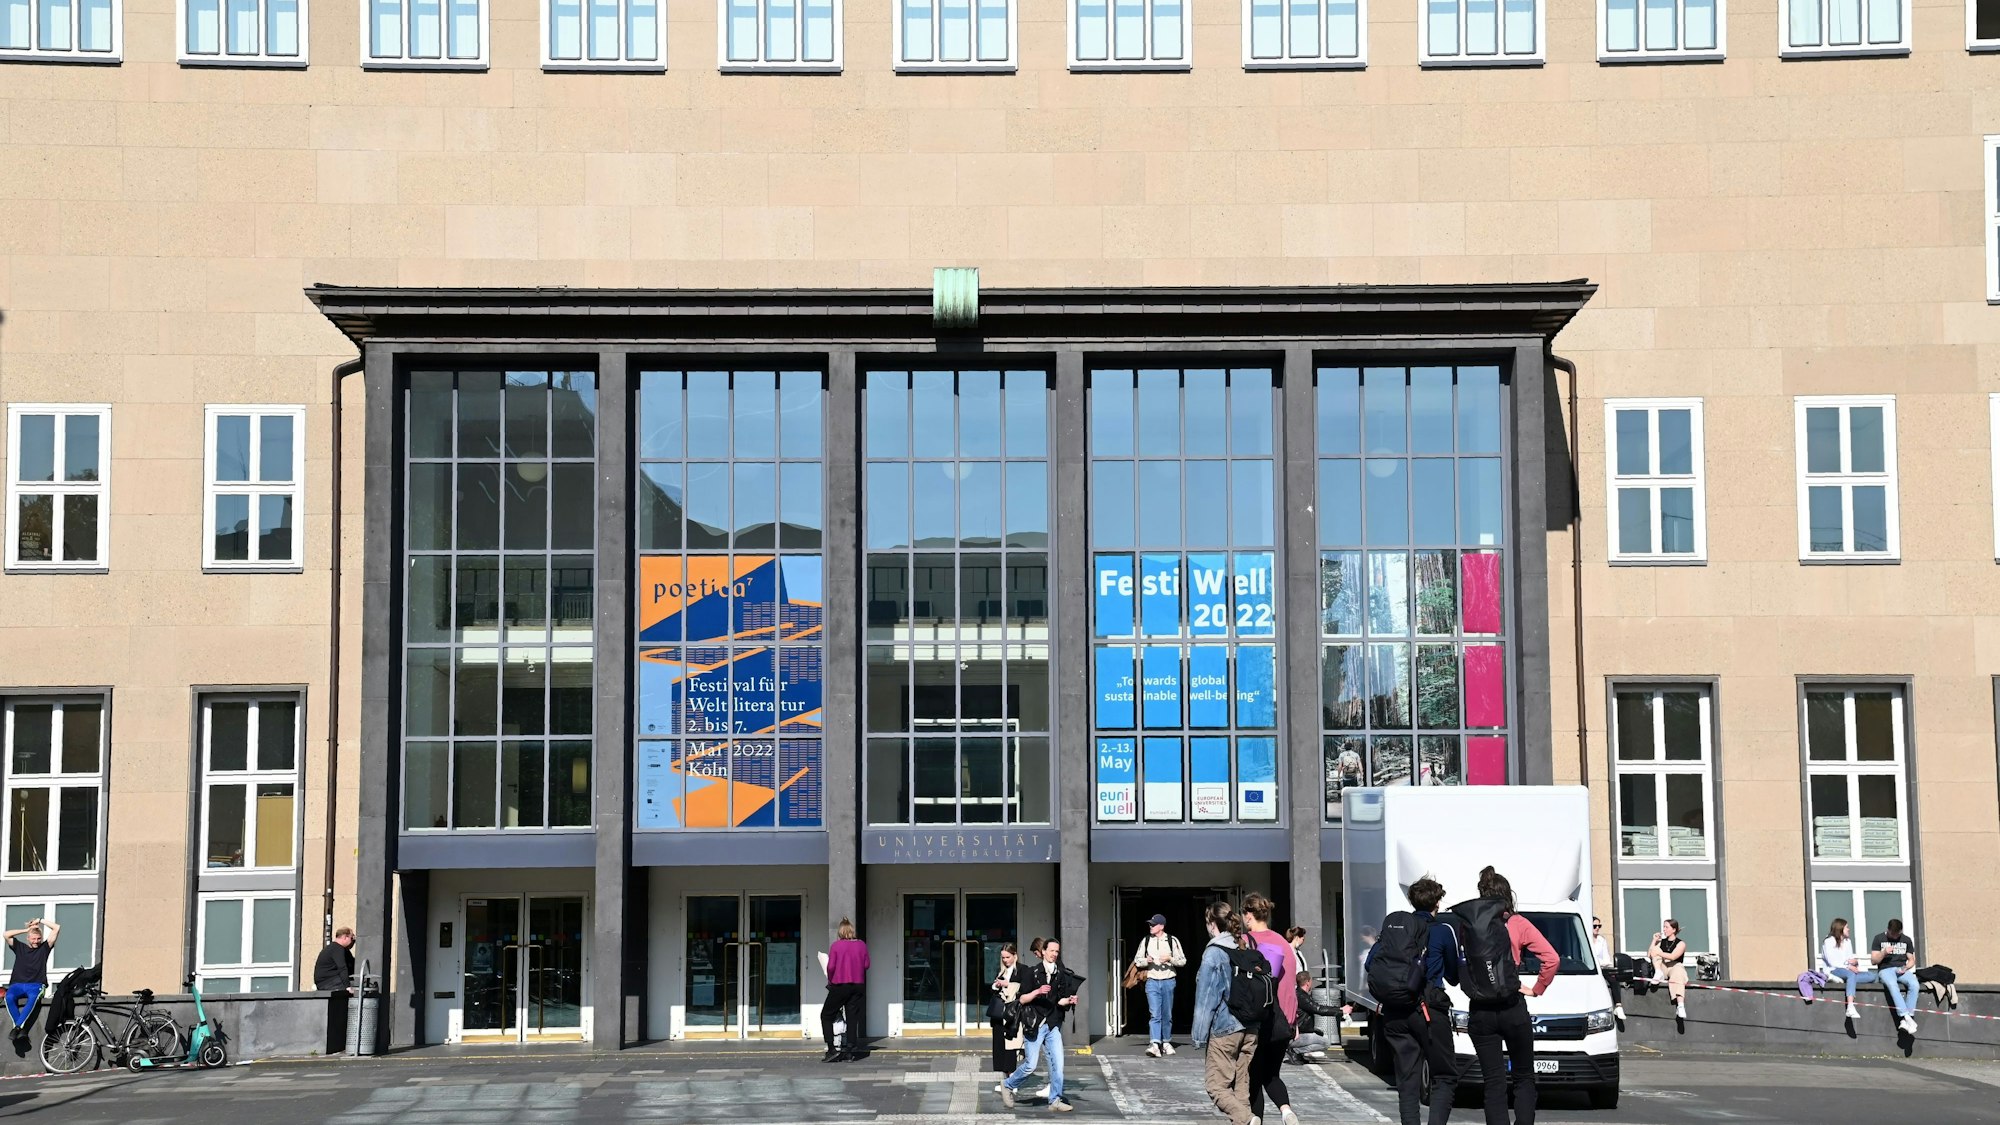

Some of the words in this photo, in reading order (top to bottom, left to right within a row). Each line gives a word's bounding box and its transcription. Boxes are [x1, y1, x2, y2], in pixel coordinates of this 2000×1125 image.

[1194, 603, 1271, 627] 2022
[689, 677, 755, 692] Festival
[759, 677, 788, 692] für
[1191, 675, 1225, 688] global
[1104, 690, 1177, 702] sustainable
[689, 697, 805, 712] Weltliteratur
[688, 720, 701, 732] 2.
[705, 717, 728, 732] bis
[735, 721, 747, 734] 7.
[689, 742, 722, 756] Mai
[733, 744, 773, 756] 2022
[688, 762, 728, 777] Köln
[1100, 755, 1133, 772] May
[1100, 788, 1129, 801] euni
[1103, 802, 1133, 815] well
[879, 833, 1039, 847] UNIVERSITÄT
[894, 848, 1024, 858] HAUPTGEBÄUDE
[1536, 1061, 1557, 1070] 9966
